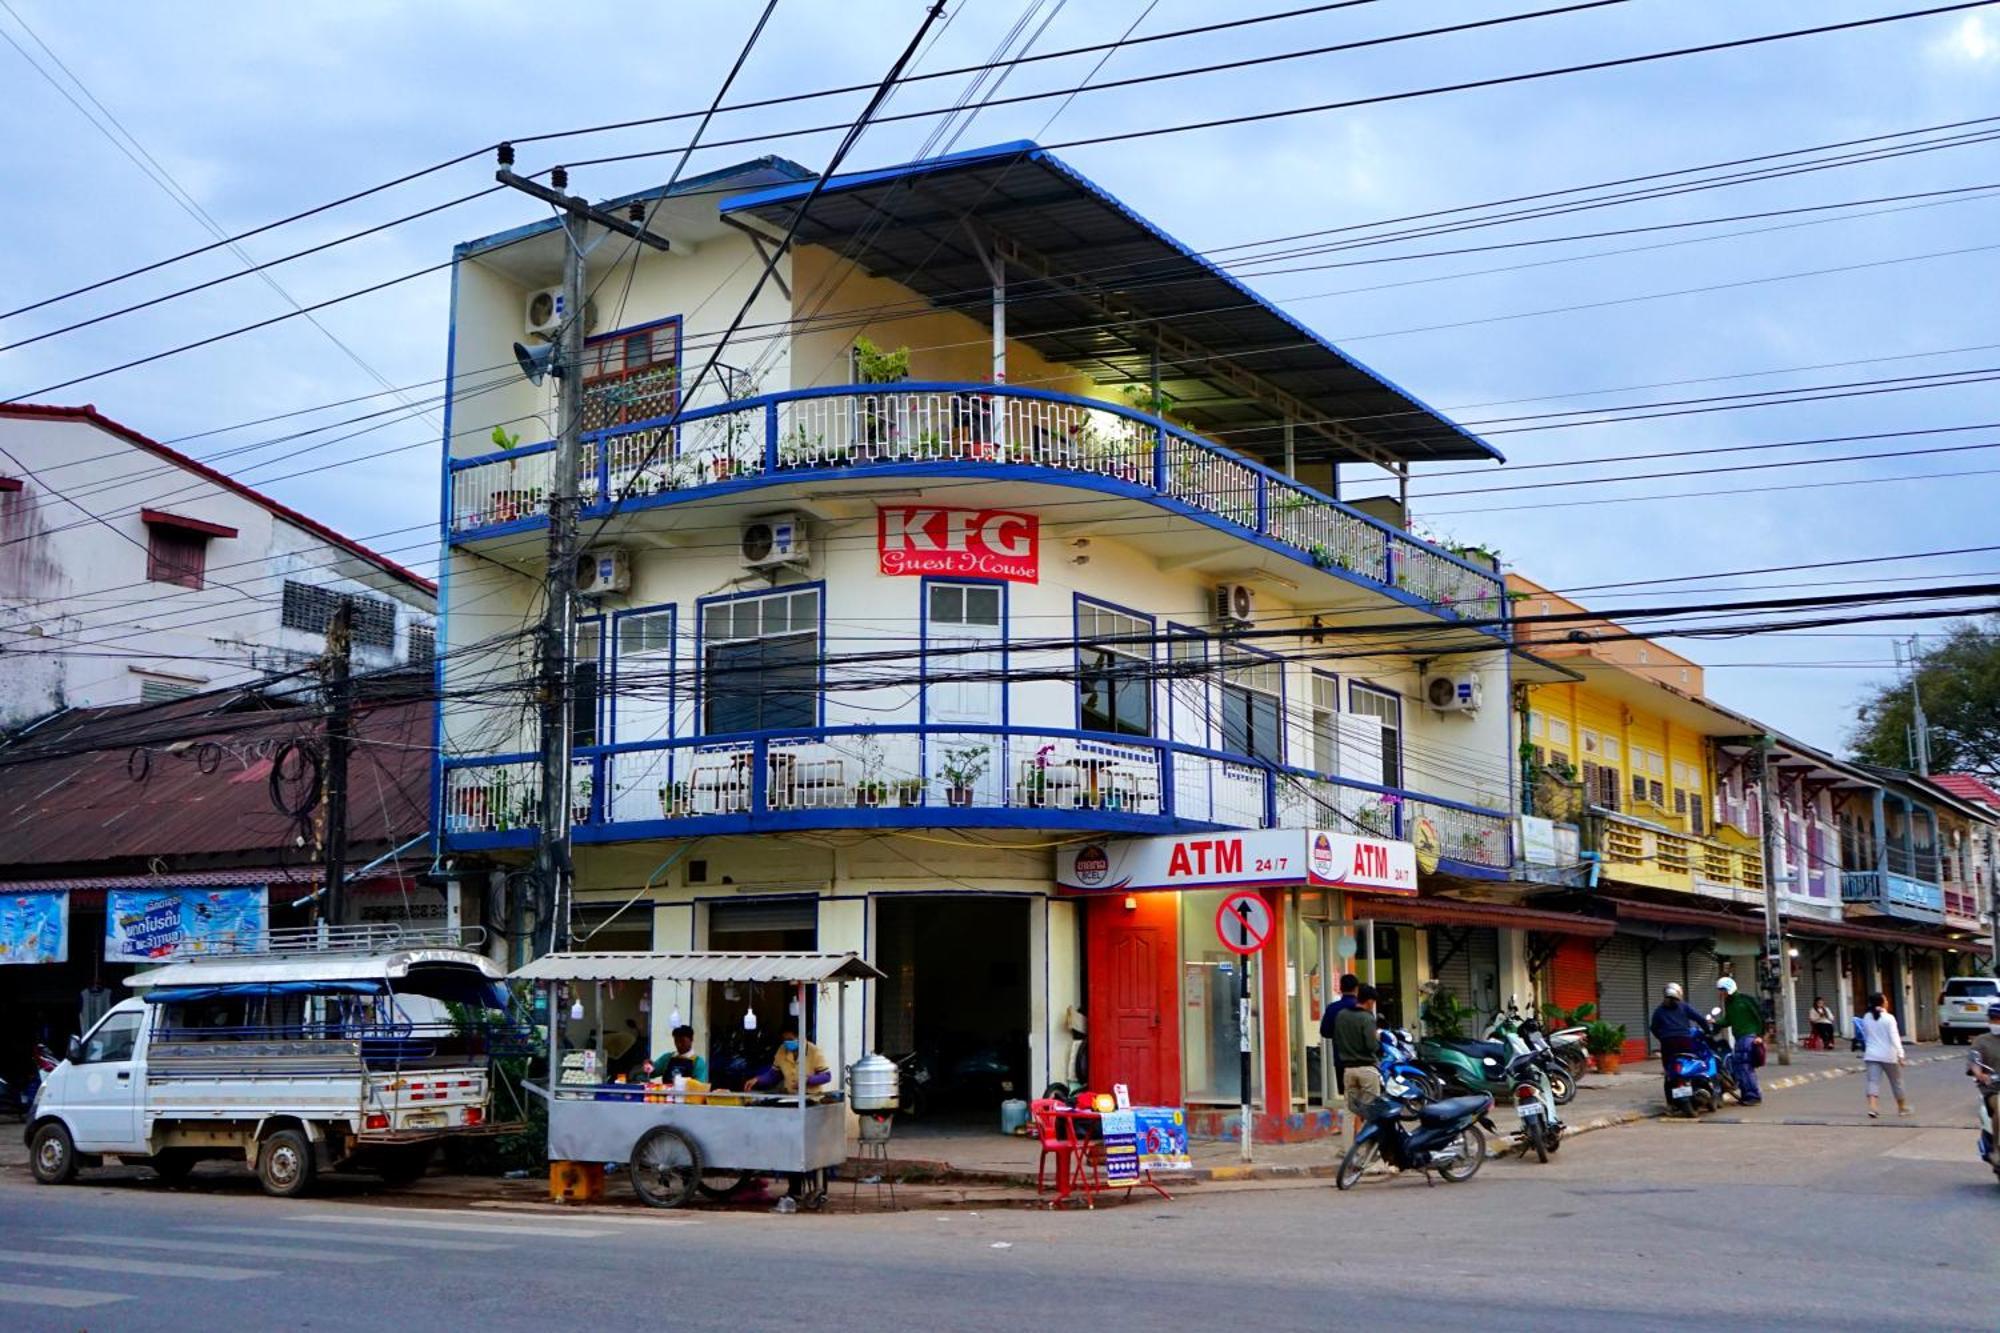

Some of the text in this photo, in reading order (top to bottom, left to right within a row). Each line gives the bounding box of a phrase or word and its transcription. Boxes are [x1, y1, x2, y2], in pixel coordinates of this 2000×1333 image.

[884, 510, 1031, 557] KFG
[882, 551, 1036, 578] Guest House
[1168, 839, 1288, 876] ATM 24/7
[1354, 843, 1388, 879] ATM
